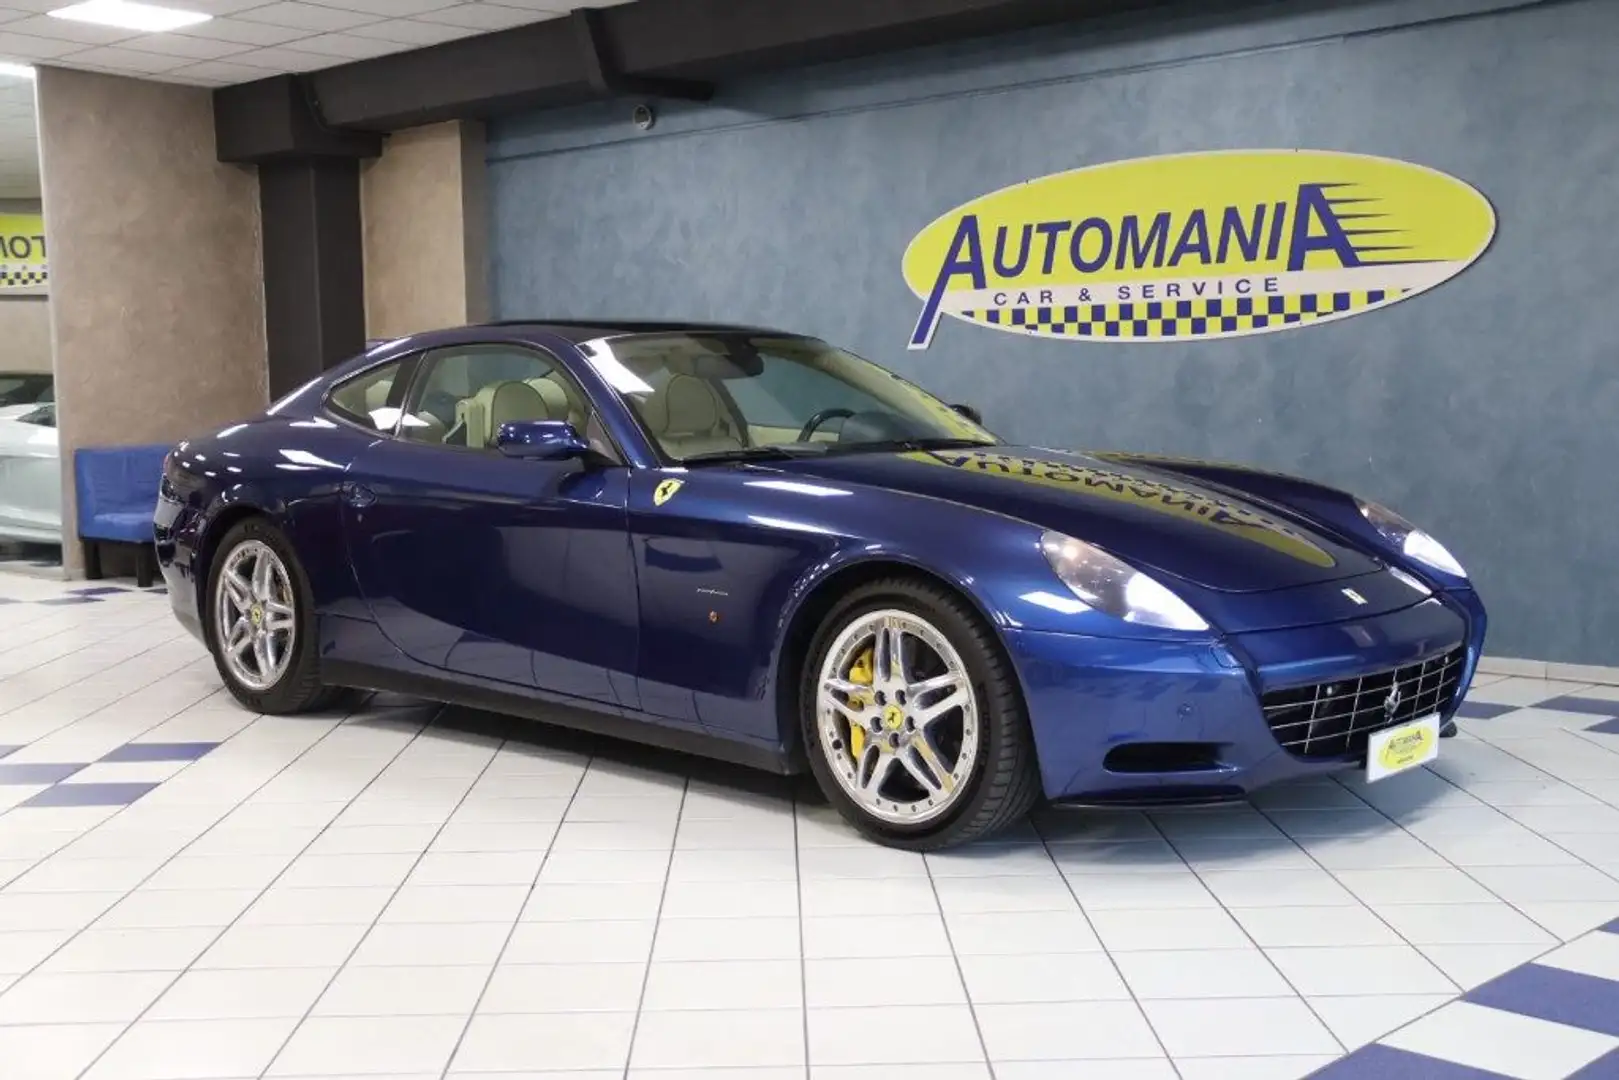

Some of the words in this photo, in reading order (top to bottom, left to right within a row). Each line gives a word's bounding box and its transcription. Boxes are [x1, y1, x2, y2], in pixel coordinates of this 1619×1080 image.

[910, 183, 1362, 344] AUTOMANIA
[994, 290, 1054, 306] CAR
[1079, 288, 1092, 302] &
[1118, 277, 1280, 300] SERVICE
